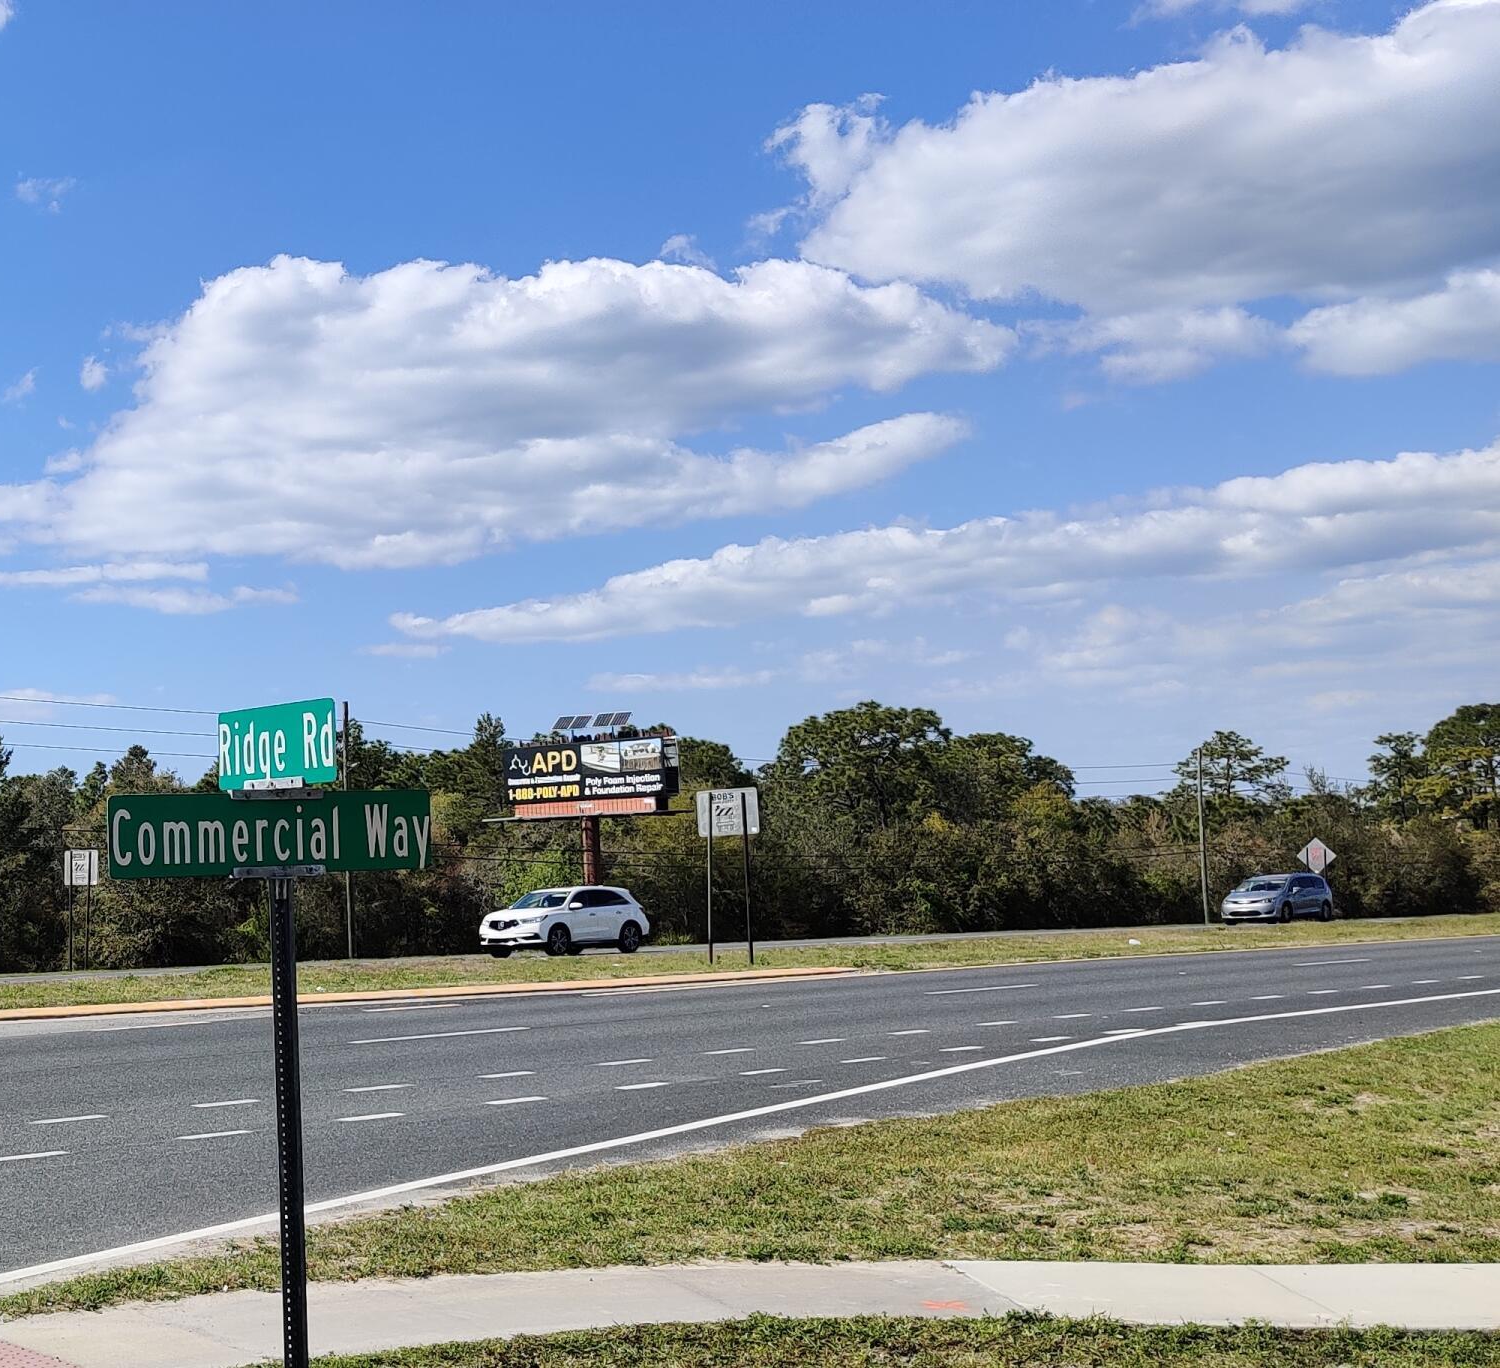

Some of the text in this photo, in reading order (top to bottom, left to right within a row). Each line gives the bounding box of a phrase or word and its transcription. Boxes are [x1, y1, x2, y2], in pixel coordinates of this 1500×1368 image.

[219, 710, 334, 780] Ridge Rd
[532, 749, 577, 774] APD
[584, 782, 664, 795] & Foundation Repair
[585, 777, 602, 787] Poly
[603, 776, 625, 785] Foam
[626, 774, 661, 785] Injection
[508, 784, 580, 801] 1-888-POLY-APD
[112, 804, 430, 869] Commercial Way
